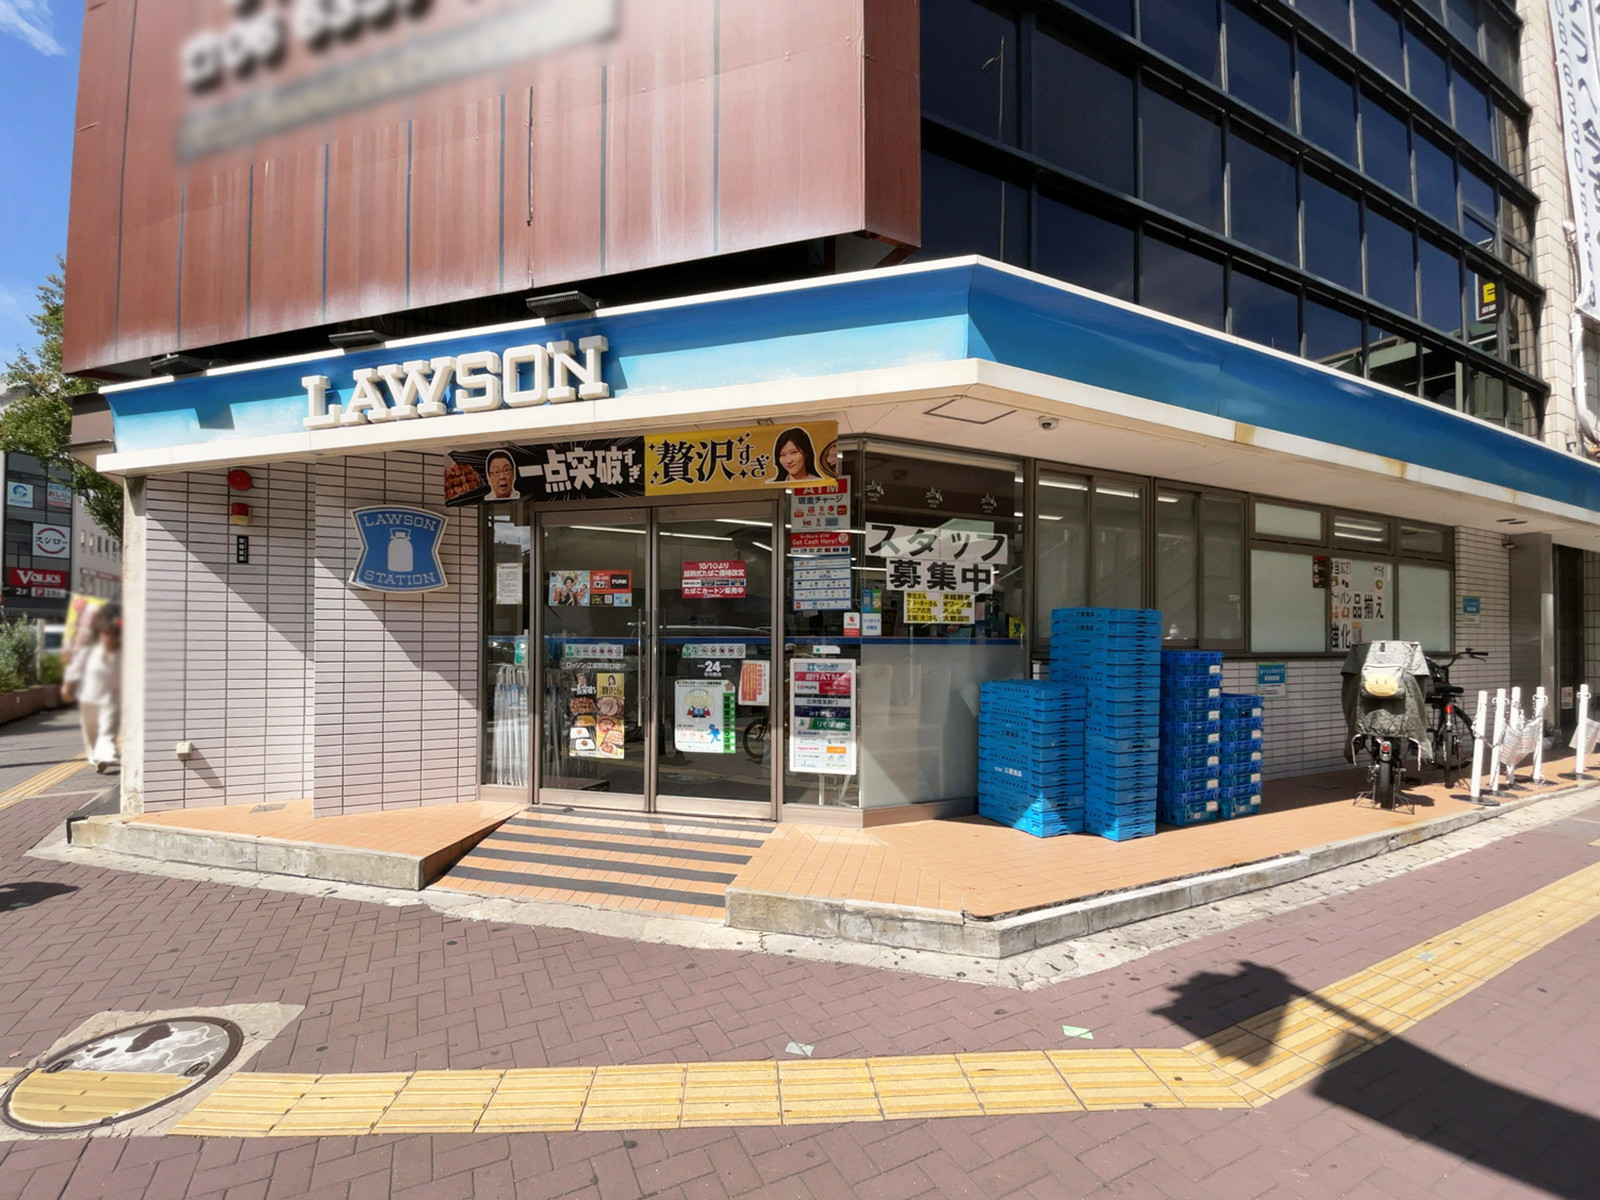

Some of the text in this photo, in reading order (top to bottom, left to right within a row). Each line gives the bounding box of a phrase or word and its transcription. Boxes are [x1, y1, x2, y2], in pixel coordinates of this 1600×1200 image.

[301, 335, 609, 430] LAWSON
[518, 446, 642, 493] 一点突破すぎ
[656, 437, 769, 486] 贅沢すぎ
[363, 513, 437, 532] LAWSON
[35, 536, 68, 545] スシロー
[868, 524, 1006, 562] スタッフ
[16, 570, 61, 585] VOLKS
[363, 569, 437, 586] STATION
[889, 559, 992, 591] 募集中
[704, 660, 721, 672] 24
